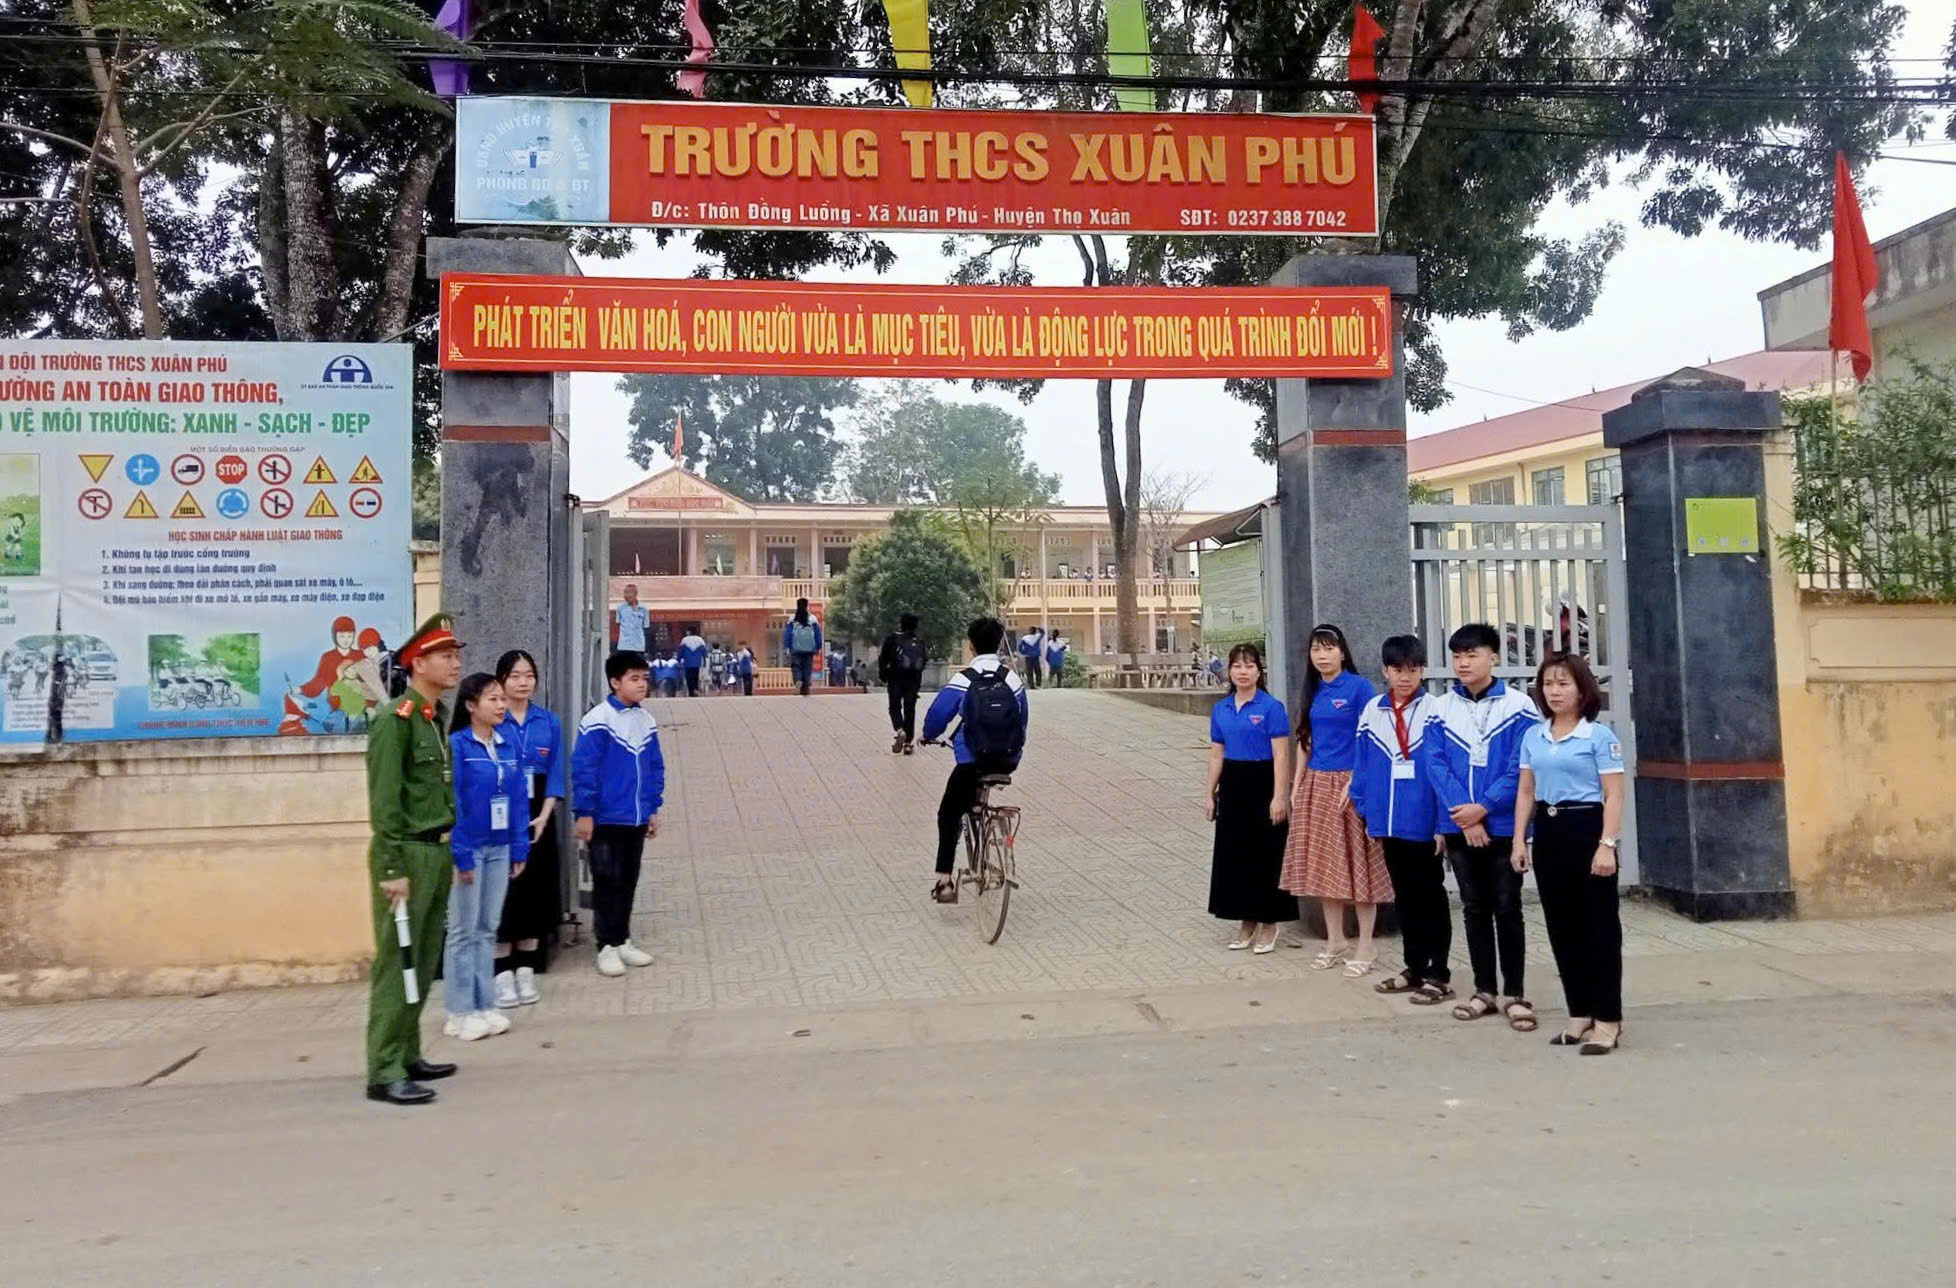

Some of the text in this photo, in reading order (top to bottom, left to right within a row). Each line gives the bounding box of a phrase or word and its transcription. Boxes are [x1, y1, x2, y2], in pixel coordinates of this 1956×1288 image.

[641, 110, 878, 178] TRƯỜNG
[901, 131, 1049, 182] THCS
[1070, 123, 1227, 184] XUÂN
[1245, 122, 1356, 185] PHÚ
[651, 201, 689, 218] Đ/c:
[698, 202, 740, 220] Thôn
[748, 198, 792, 224] Đồng
[868, 204, 890, 221] Xã
[896, 206, 939, 223] Xuân
[946, 205, 978, 223] Phú
[994, 206, 1045, 228] Huyện
[1052, 208, 1083, 228] Thọ
[1089, 207, 1131, 225] Xuân
[1180, 209, 1346, 226] SĐT: 0237 388 7042
[473, 296, 524, 348] PHÁT
[529, 289, 587, 349] TRIỂN
[598, 299, 637, 350] VĂN
[643, 300, 687, 357] HOÁ,
[693, 308, 732, 353] CON
[739, 302, 797, 354] NGƯỜI
[802, 303, 839, 354] VỪA
[844, 304, 867, 355] LÀ
[871, 313, 914, 365] MỤC
[919, 305, 965, 361] TIÊU,
[970, 306, 1007, 357] VỪA
[1011, 307, 1034, 357] LÀ
[1039, 307, 1089, 366] ĐỘNG
[1094, 310, 1128, 366] LỰC
[1133, 315, 1192, 357] TRONG
[1198, 308, 1235, 361] QUÁ
[1238, 308, 1292, 357] TRÌNH
[1296, 299, 1327, 357] ĐỔI
[1331, 307, 1367, 356] MỚI
[9, 352, 36, 374] ĐỘI
[41, 352, 102, 371] TRƯỜNG
[107, 355, 146, 371] THCS
[151, 354, 192, 372] XUÂN
[197, 354, 228, 372] PHÚ
[62, 381, 91, 402] AN
[98, 377, 151, 402] TOÀN
[158, 382, 205, 403] GIAO
[211, 379, 283, 405] THÔNG,
[10, 408, 34, 436] VỆ
[42, 408, 82, 432] MÔI
[89, 408, 176, 433] TRƯỜNG:
[183, 413, 237, 433] XANH
[258, 413, 311, 438] SẠCH
[332, 413, 370, 438] ĐẸP
[218, 464, 245, 476] STOP
[168, 528, 343, 543] HỌC SINH CHẤP HÀNH LUẬT GIAO THÔNG
[102, 550, 109, 558] 1.
[102, 565, 110, 574] 2.
[112, 565, 127, 574] Khi
[128, 565, 142, 574] tan
[145, 565, 160, 576] học
[240, 565, 256, 574] quy
[103, 580, 110, 589] 3.
[112, 580, 126, 589] Khi
[308, 579, 317, 587] xe
[205, 595, 214, 603] xe
[341, 593, 350, 601] xe
